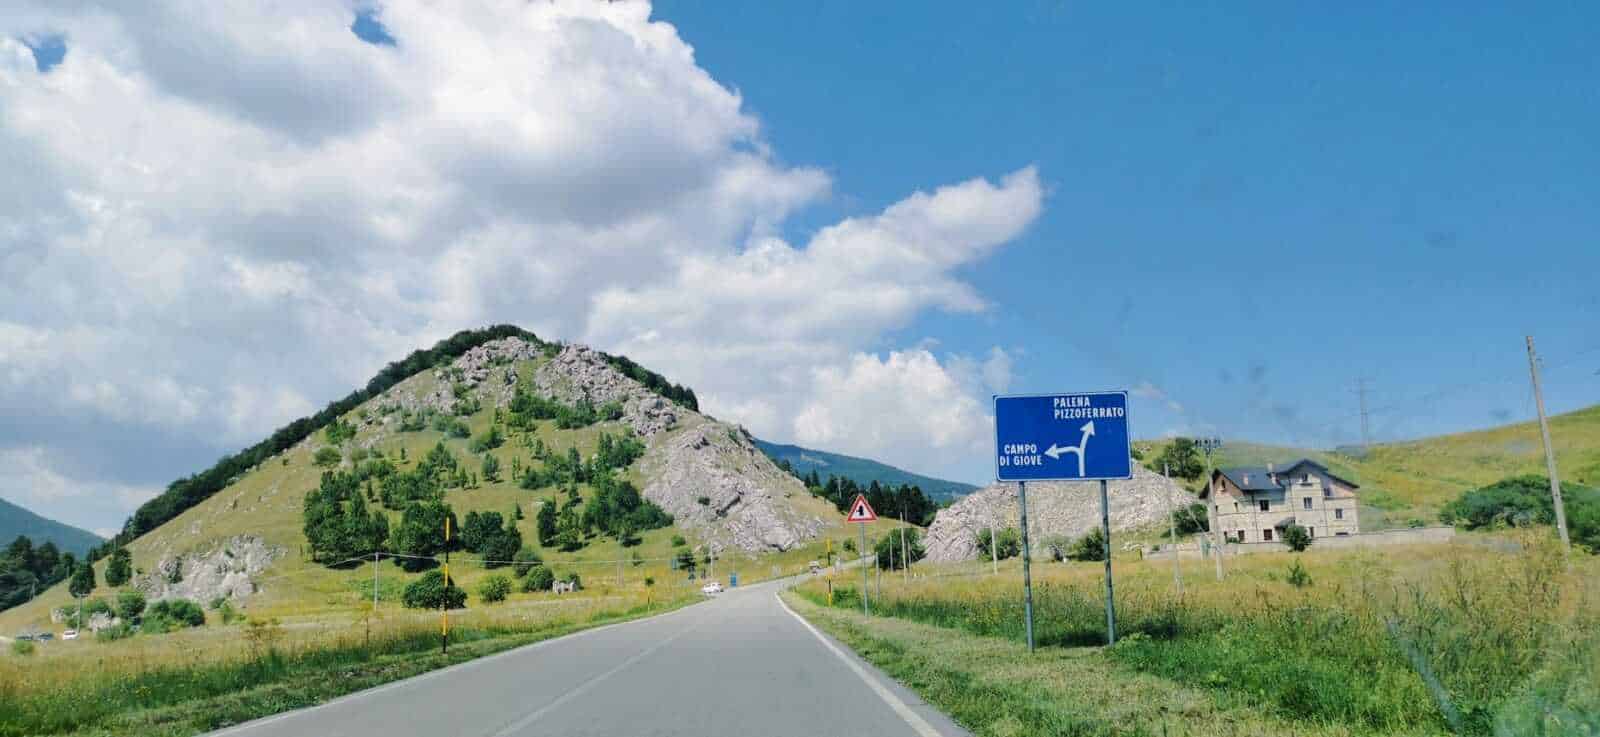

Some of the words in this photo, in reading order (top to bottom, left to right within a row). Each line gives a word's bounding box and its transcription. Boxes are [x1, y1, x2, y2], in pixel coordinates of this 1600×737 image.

[1054, 396, 1090, 408] PALENA
[1054, 407, 1124, 419] PIZZOFERRATO
[1004, 444, 1037, 455] CAMPO
[1000, 456, 1010, 466] DI
[1013, 455, 1042, 466] GIOVE
